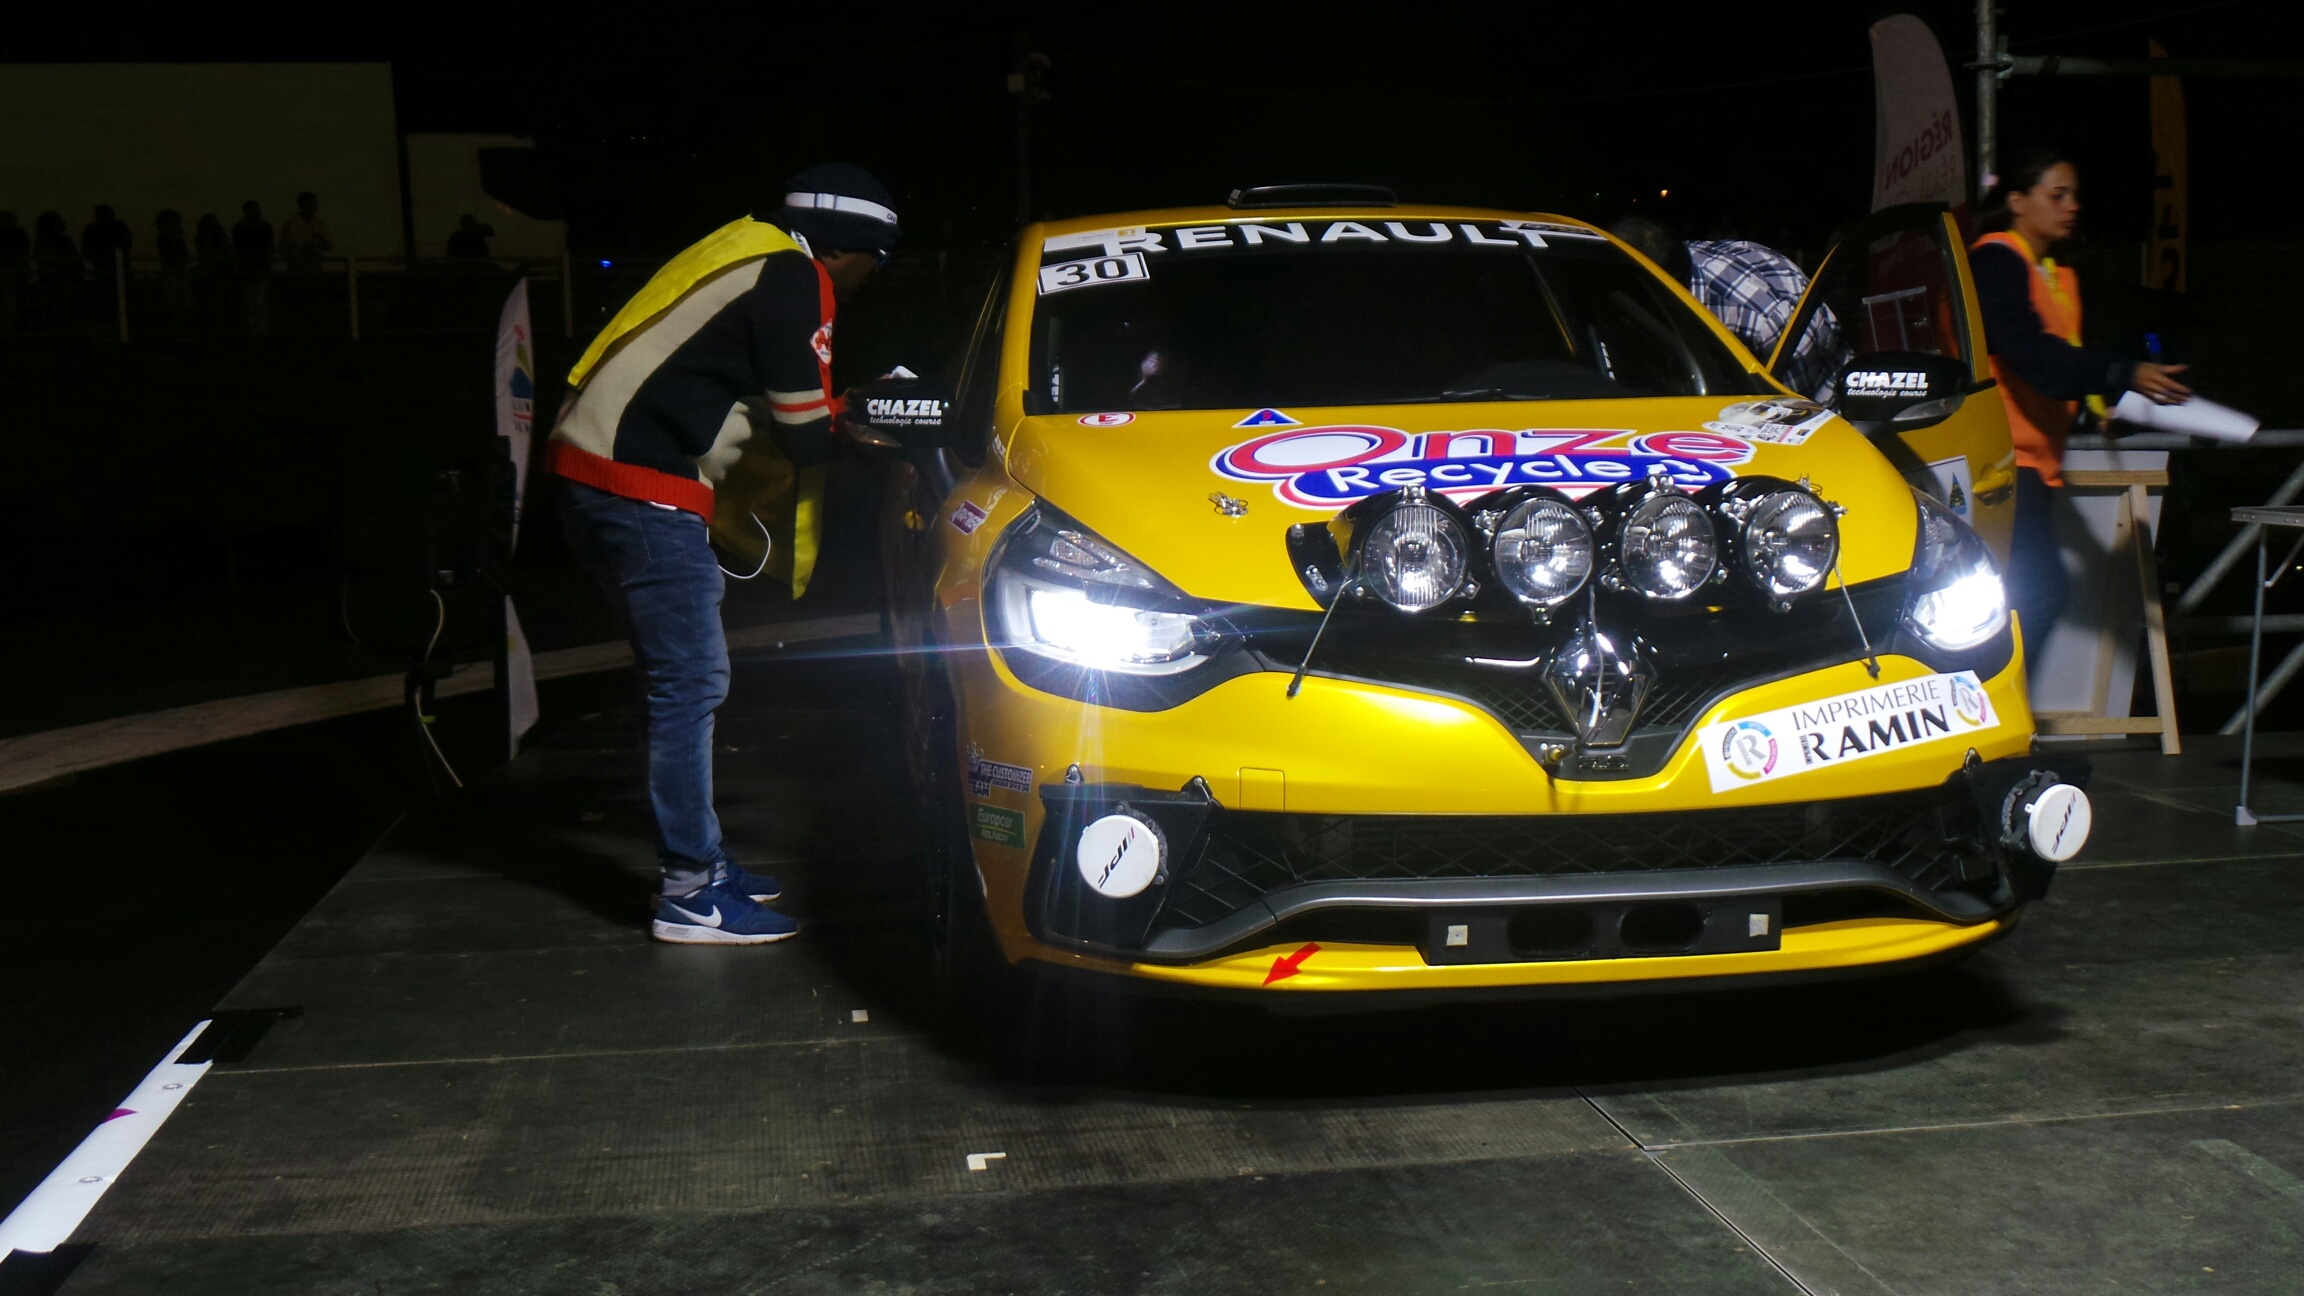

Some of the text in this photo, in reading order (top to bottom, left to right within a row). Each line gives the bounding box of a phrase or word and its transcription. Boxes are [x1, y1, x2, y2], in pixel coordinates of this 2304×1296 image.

[1101, 221, 1549, 257] RENAULT
[1055, 257, 1130, 286] 30
[1846, 371, 1929, 389] CHAZEL
[1899, 388, 1928, 397] course
[867, 398, 942, 416] CHAZEL
[914, 417, 942, 425] course
[1214, 426, 1751, 480] Onze
[1792, 679, 1941, 731] IMPRIMERIE
[1799, 703, 1950, 765] RAMIN
[978, 807, 1013, 829] Europcar
